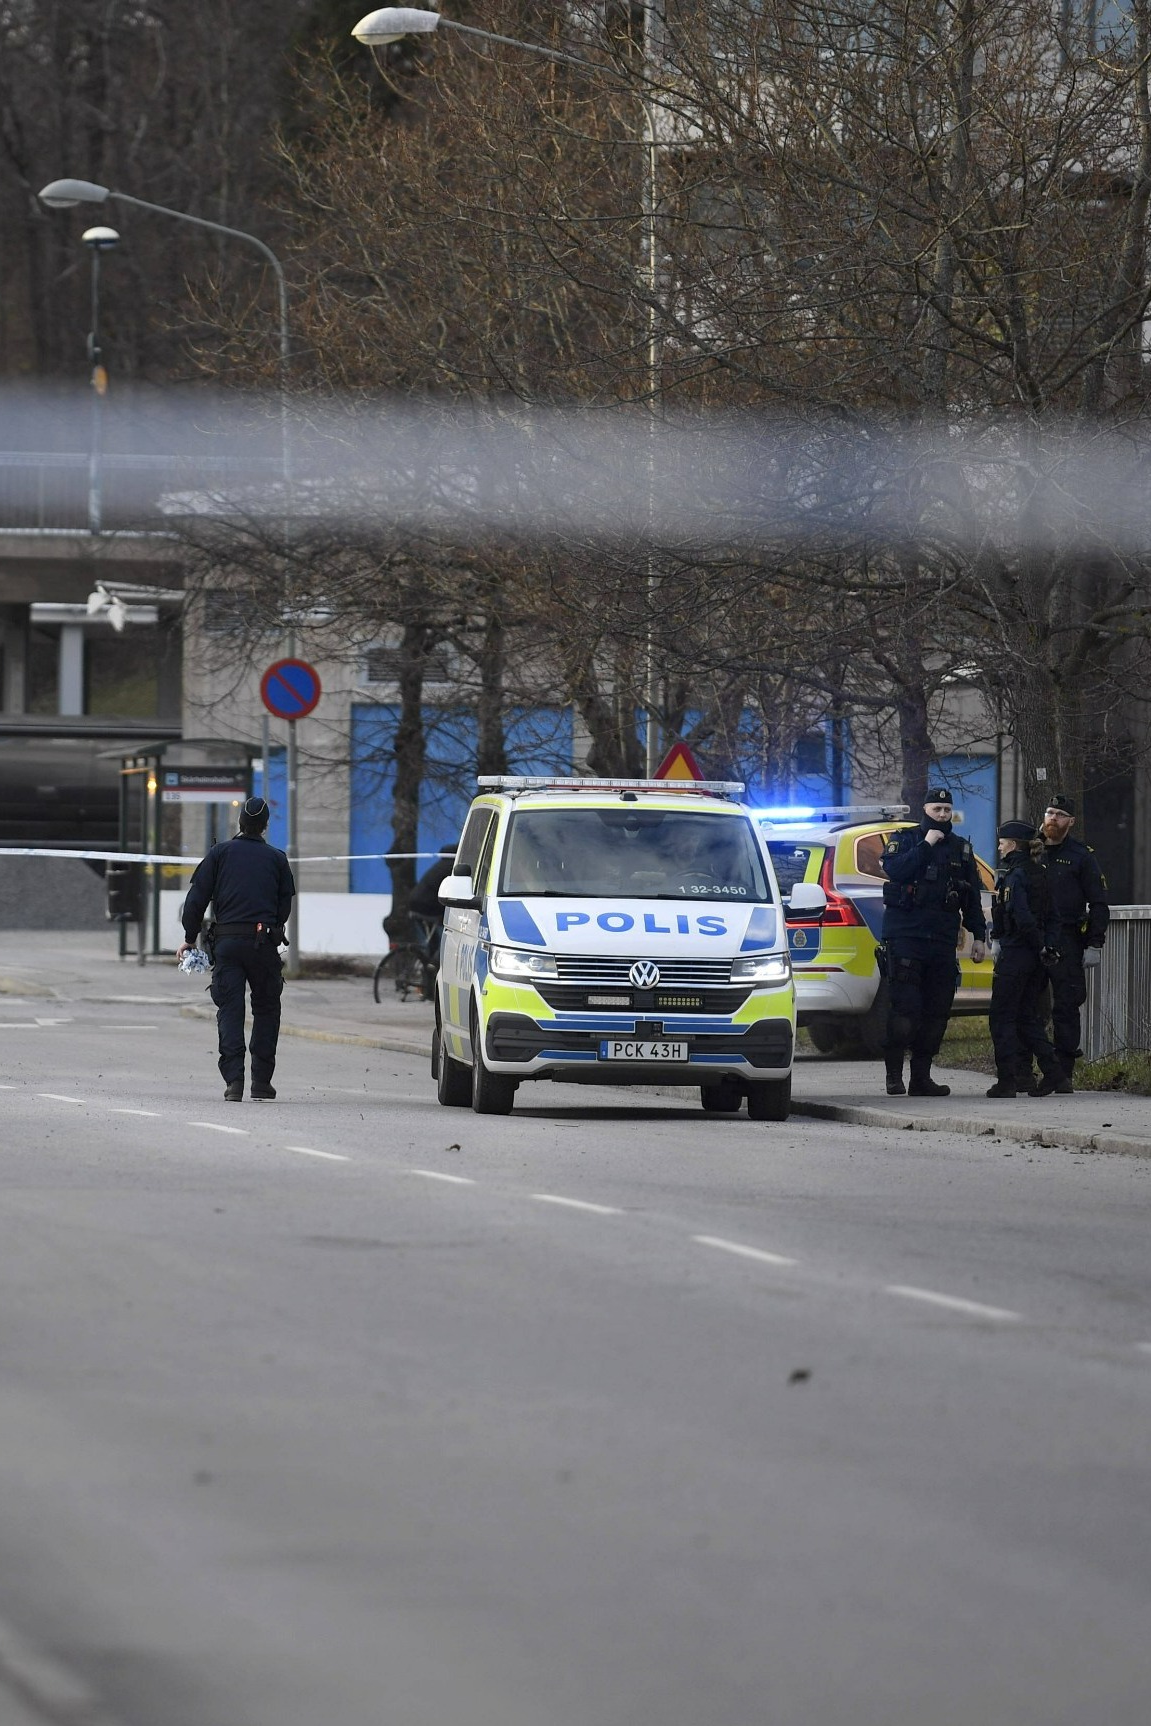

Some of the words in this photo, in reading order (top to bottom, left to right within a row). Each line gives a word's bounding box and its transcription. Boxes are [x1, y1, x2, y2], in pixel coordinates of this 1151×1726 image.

[678, 885, 686, 894] 1
[690, 885, 747, 896] 32-3450
[555, 912, 728, 937] POLIS
[613, 1043, 644, 1058] PCK
[649, 1043, 681, 1058] 43H
